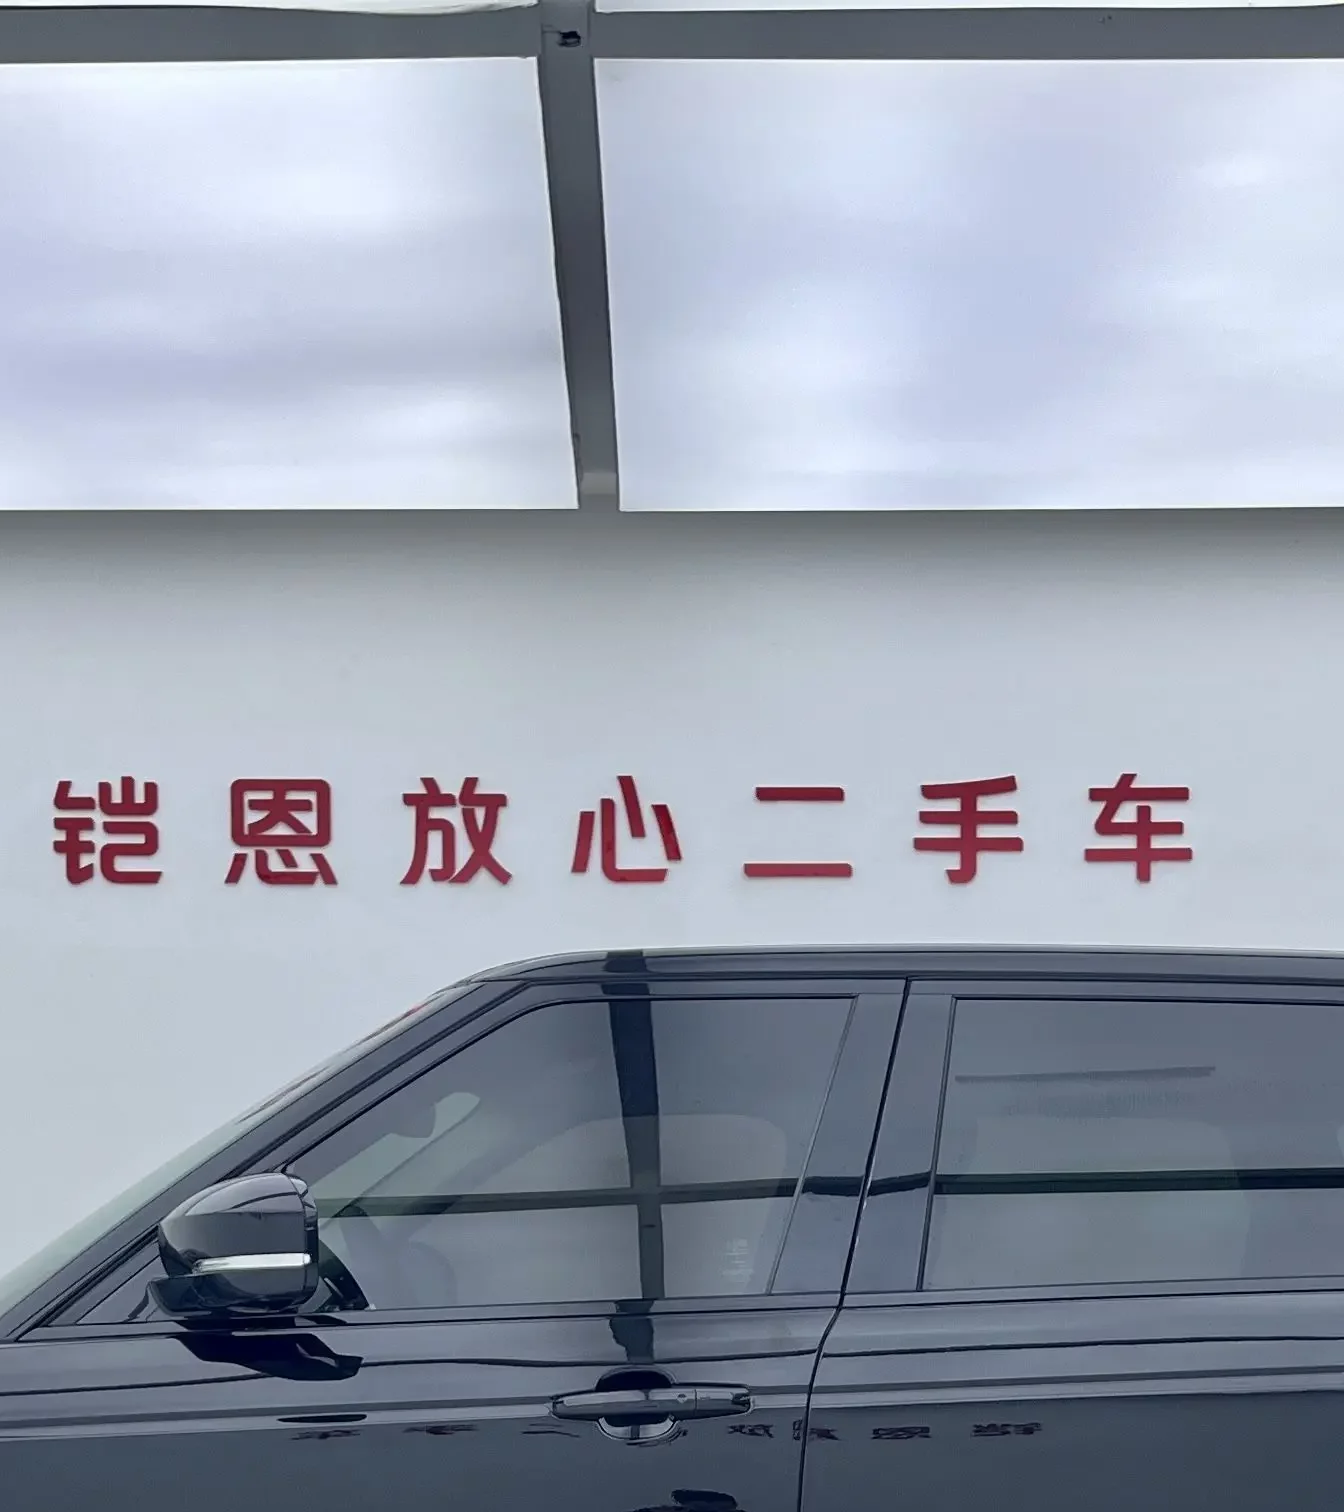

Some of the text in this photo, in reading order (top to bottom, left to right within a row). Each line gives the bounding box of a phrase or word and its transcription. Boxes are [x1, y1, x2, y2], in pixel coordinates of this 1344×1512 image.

[53, 774, 1193, 885] 铠恩放心二手车
